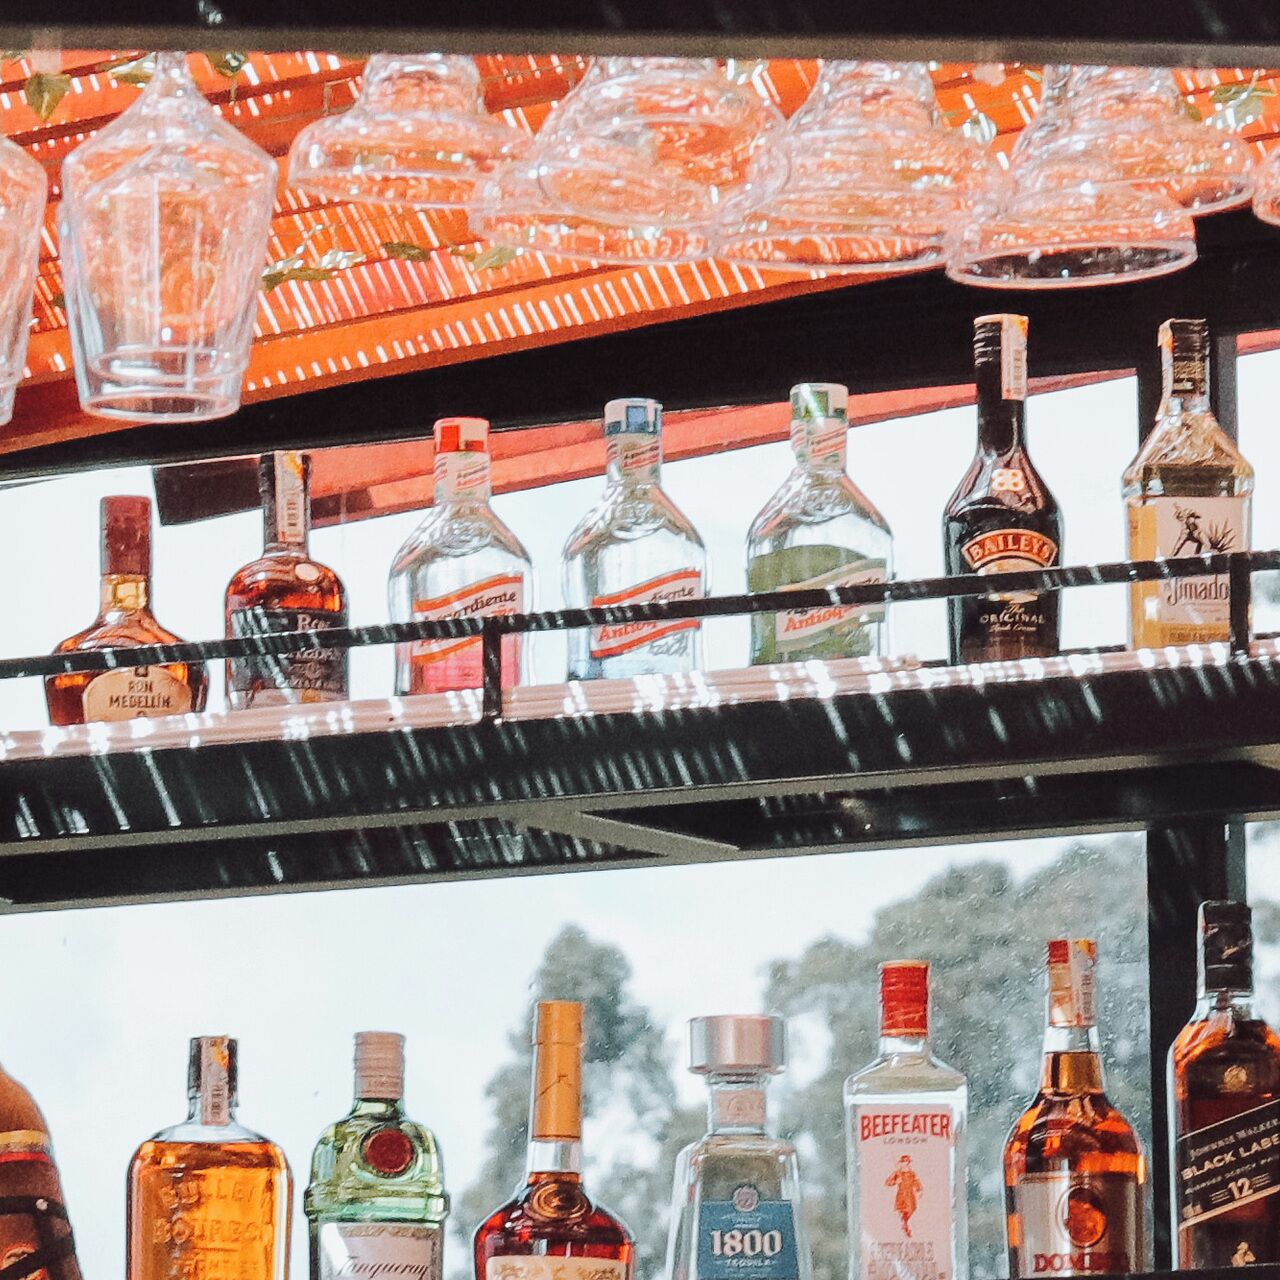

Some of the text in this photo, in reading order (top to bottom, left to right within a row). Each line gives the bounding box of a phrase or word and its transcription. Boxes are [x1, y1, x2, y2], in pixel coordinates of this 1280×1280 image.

[969, 534, 1051, 562] BAILEYS
[128, 679, 153, 692] RON
[861, 1113, 951, 1142] BEEFEATER
[1181, 1150, 1236, 1181] BLACK
[1228, 1177, 1253, 1200] 12
[710, 1229, 784, 1257] 1800
